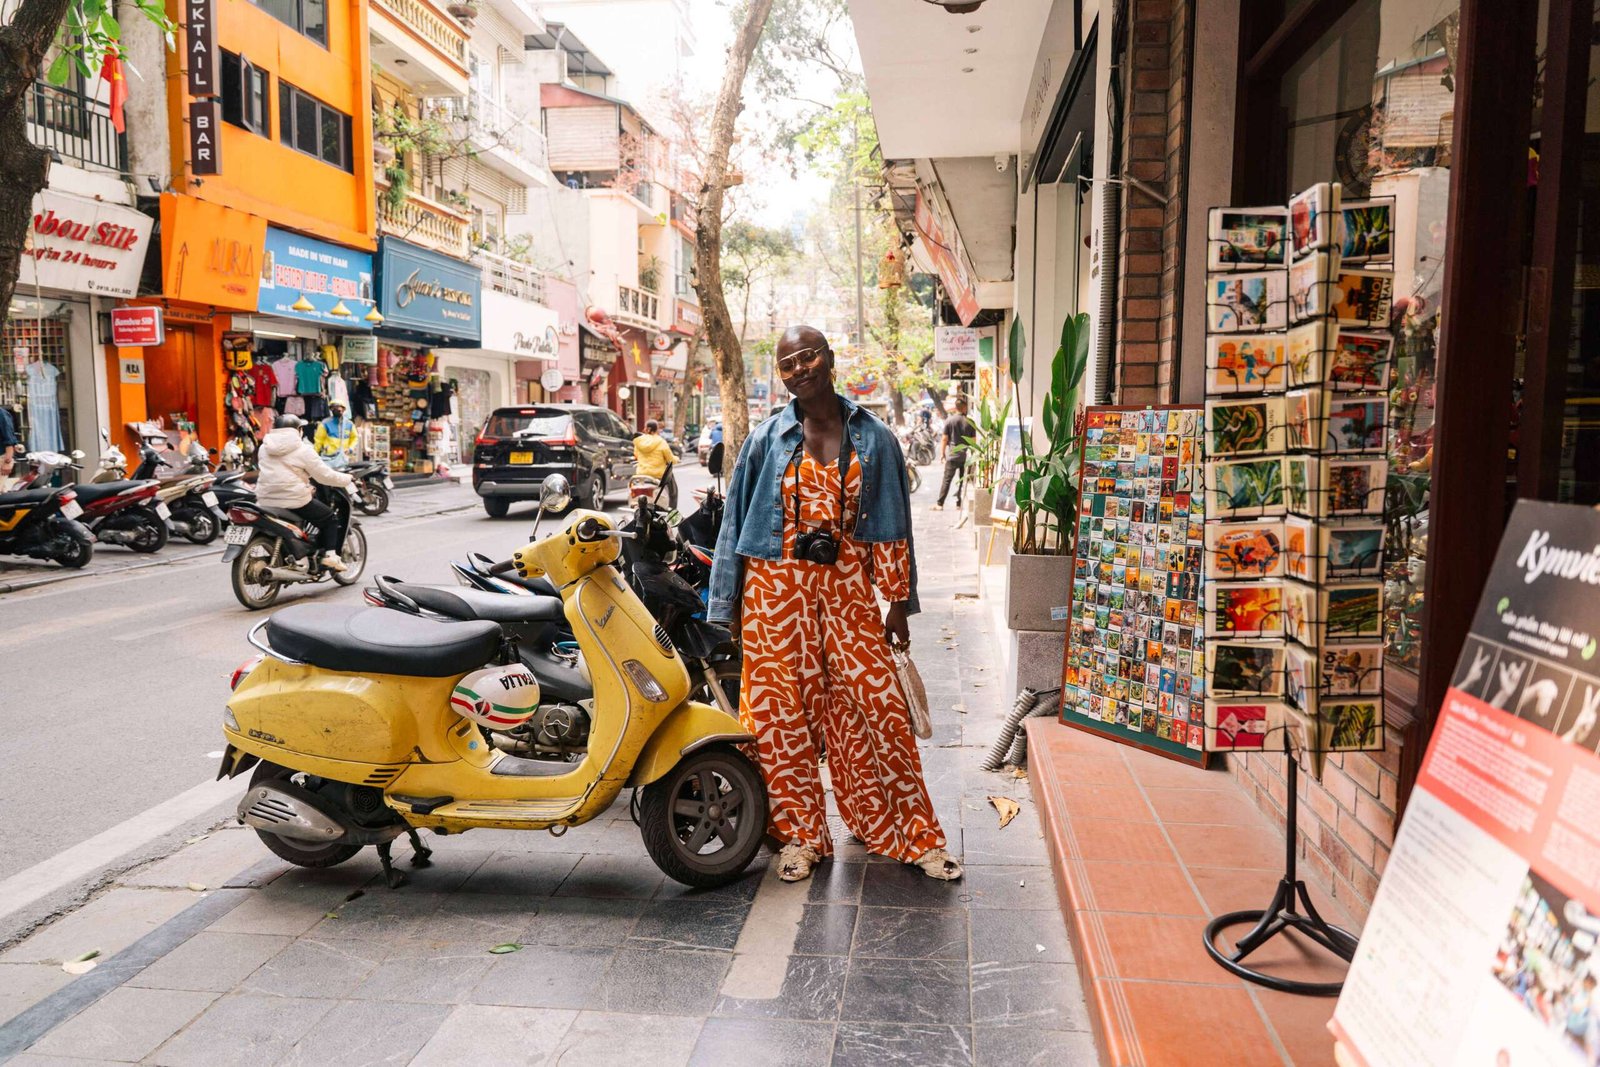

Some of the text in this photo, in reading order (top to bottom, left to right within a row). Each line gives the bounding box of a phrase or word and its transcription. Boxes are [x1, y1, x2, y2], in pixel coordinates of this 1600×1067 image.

[191, 0, 211, 161] KTAIL BAR
[91, 221, 138, 251] Silk
[61, 250, 81, 263] 24
[81, 254, 117, 270] hours
[288, 245, 348, 269] MADE IN VIET NAM
